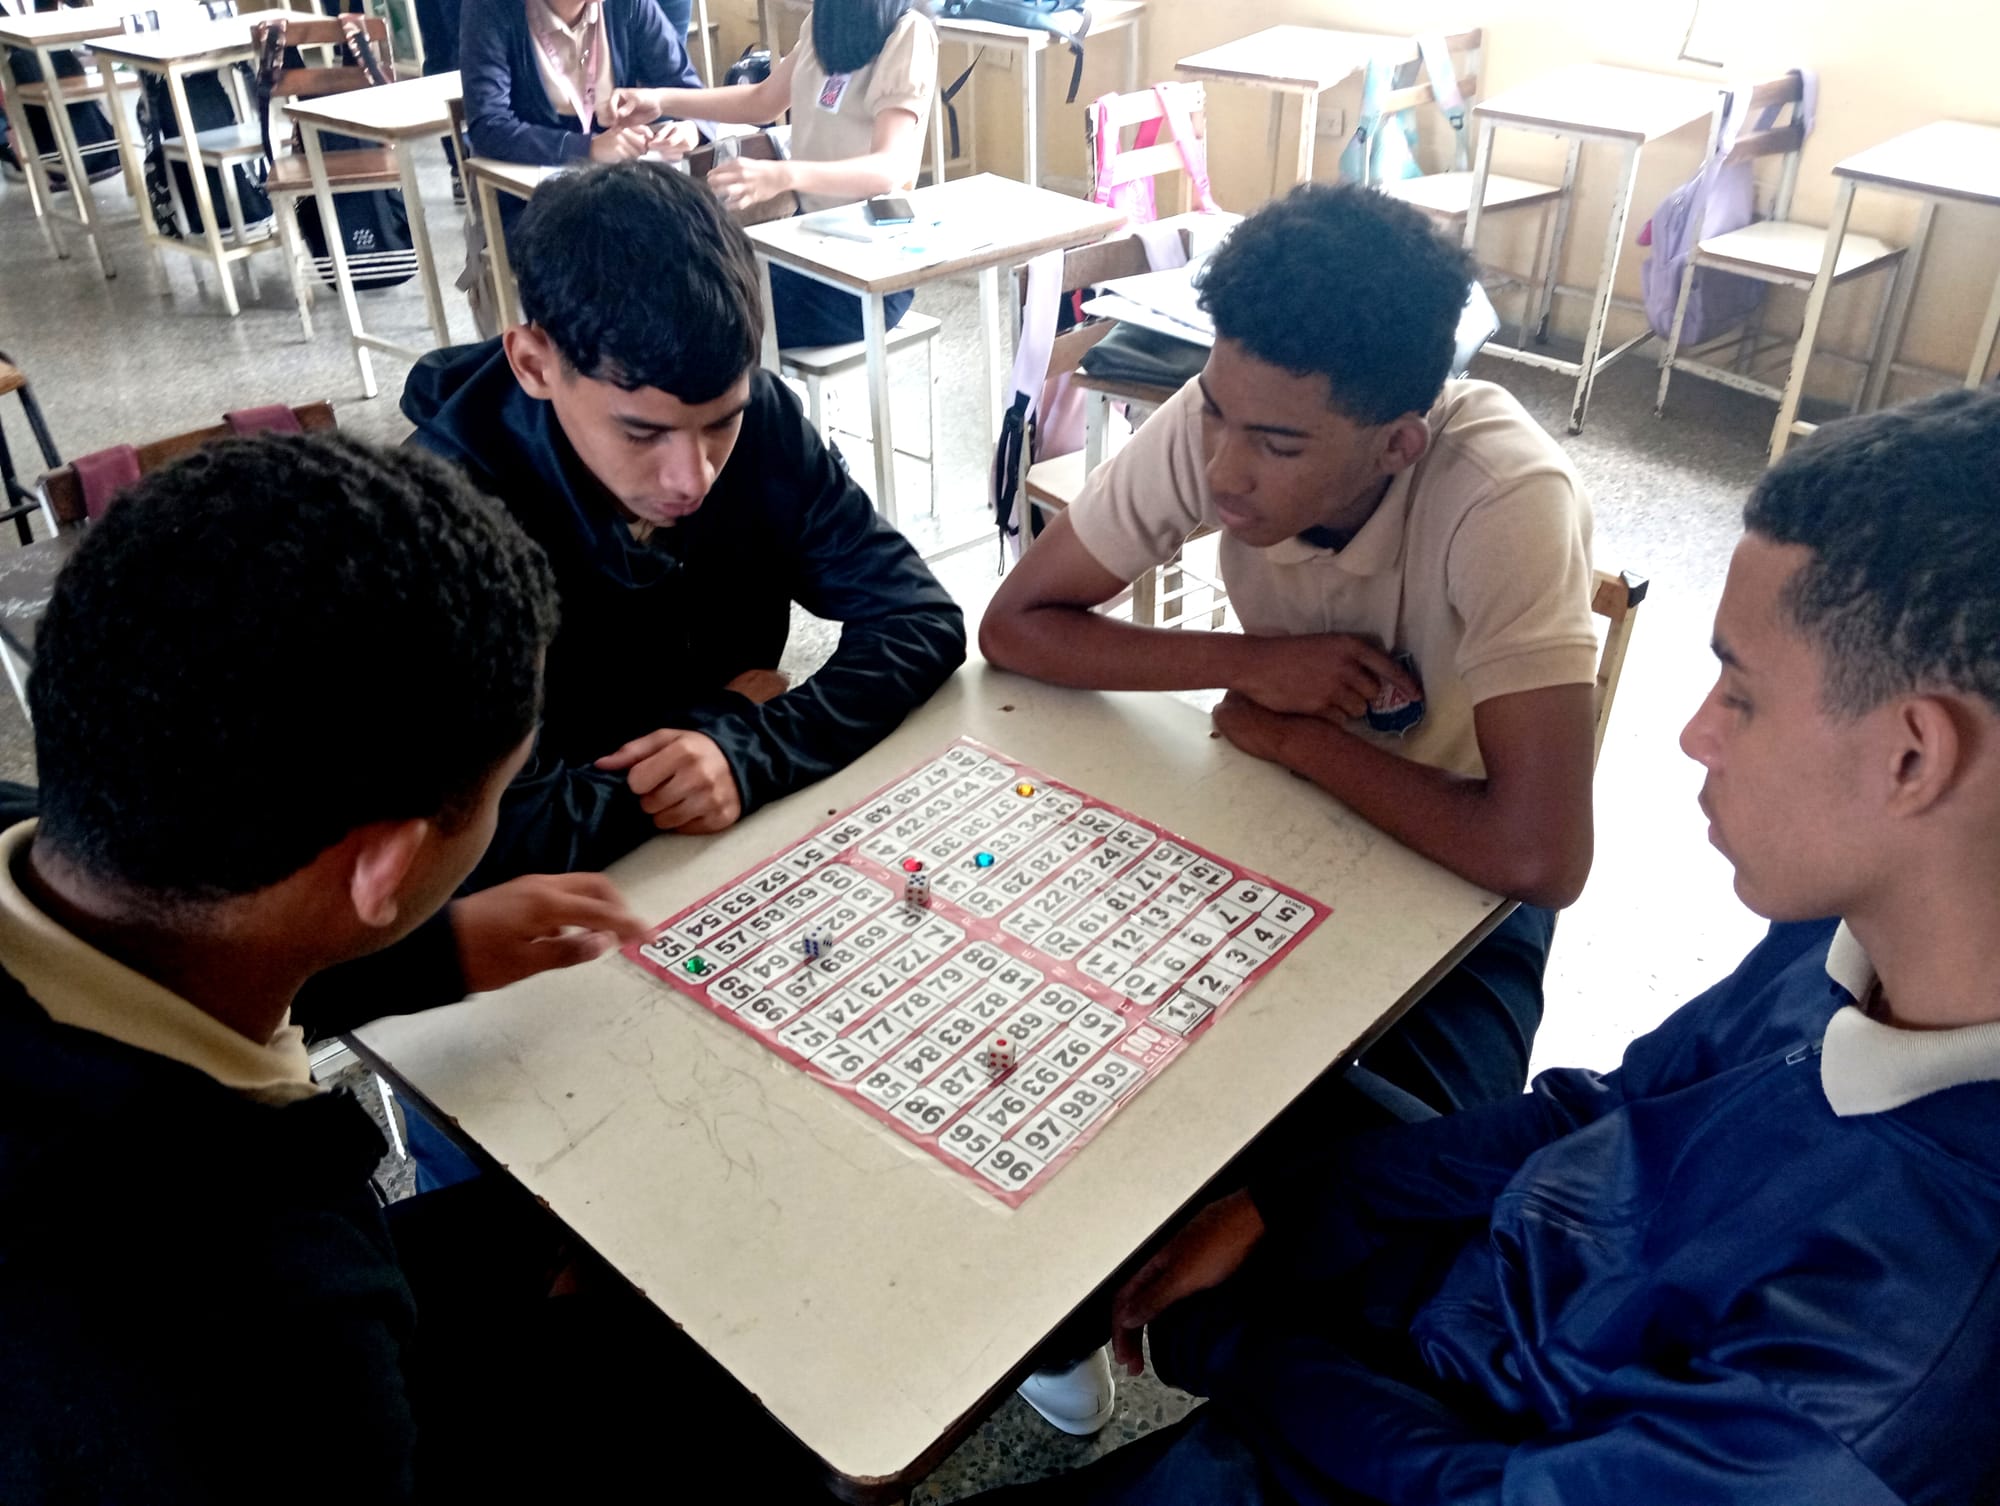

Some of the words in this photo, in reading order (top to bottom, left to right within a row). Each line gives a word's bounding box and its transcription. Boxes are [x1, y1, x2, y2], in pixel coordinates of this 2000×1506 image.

[946, 750, 976, 768] 46
[925, 767, 949, 787] 47
[976, 765, 1006, 783] 45
[893, 785, 921, 804] 48
[953, 781, 980, 800] 44
[865, 804, 892, 825] 49
[925, 799, 952, 818] 43
[991, 799, 1018, 819] 37
[1041, 797, 1075, 816] 35
[895, 818, 925, 838] 42
[960, 817, 991, 837] 38
[1017, 812, 1048, 832] 34
[1078, 814, 1114, 833] 26
[832, 824, 863, 845] 50
[990, 832, 1021, 851] 33
[1060, 831, 1089, 851] 27
[1113, 830, 1149, 849] 25
[866, 838, 898, 856] 41
[931, 836, 962, 858] 39
[1090, 847, 1122, 869] 24
[1153, 848, 1186, 867] 16
[794, 849, 825, 869] 51
[1030, 851, 1062, 872] 28
[755, 871, 790, 893] 52
[820, 869, 853, 890] 60
[934, 874, 967, 894] 31
[1002, 871, 1034, 894] 29
[1062, 867, 1094, 891] 23
[1136, 870, 1163, 891] 17
[1189, 866, 1221, 887] 15
[721, 892, 757, 914] 53
[784, 887, 818, 909] 59
[852, 887, 885, 908] 61
[968, 891, 1003, 912] 30
[1034, 889, 1068, 913] 22
[1106, 891, 1137, 911] 18
[1167, 882, 1197, 905] 14
[1238, 890, 1259, 904] 6
[686, 914, 722, 937] 54
[750, 908, 785, 931] 58
[822, 908, 857, 930] 62
[888, 906, 922, 928] 70
[1009, 913, 1045, 934] 21
[1078, 912, 1109, 934] 19
[1219, 909, 1241, 925] 7
[1275, 906, 1298, 923] 5
[715, 930, 748, 955] 57
[854, 926, 888, 949] 69
[922, 925, 957, 947] 71
[1045, 931, 1083, 954] 20
[1111, 929, 1145, 950] 12
[1190, 933, 1213, 947] 8
[1254, 927, 1275, 942] 4
[651, 935, 687, 957] 55
[1225, 949, 1249, 964] 3
[753, 955, 789, 979] 64
[820, 949, 855, 973] 68
[893, 949, 931, 973] 72
[961, 949, 998, 971] 80
[1086, 953, 1119, 975] 11
[1163, 957, 1187, 972] 9
[719, 976, 755, 1000] 65
[785, 971, 816, 998] 67
[860, 972, 899, 998] 73
[926, 968, 964, 993] 79
[998, 968, 1035, 992] 81
[1124, 974, 1158, 997] 10
[1198, 974, 1223, 992] 2
[751, 997, 788, 1022] 66
[826, 998, 864, 1024] 74
[892, 993, 931, 1017] 78
[970, 992, 1008, 1018] 82
[1040, 990, 1077, 1015] 90
[790, 1021, 829, 1048] 75
[857, 1017, 893, 1046] 77
[938, 1018, 975, 1046] 83
[1006, 1013, 1042, 1040] 89
[1079, 1012, 1118, 1038] 91
[1120, 1026, 1162, 1057] 100
[826, 1044, 864, 1072] 76
[904, 1045, 942, 1074] 84
[1052, 1039, 1091, 1067] 92
[866, 1072, 908, 1099] 85
[940, 1066, 975, 1096] 87
[1021, 1067, 1059, 1096] 93
[1091, 1061, 1128, 1089] 99
[904, 1095, 946, 1125] 86
[987, 1096, 1026, 1127] 94
[1059, 1090, 1097, 1119] 98
[950, 1124, 992, 1153] 95
[1025, 1117, 1061, 1150] 97
[990, 1150, 1033, 1181] 96
